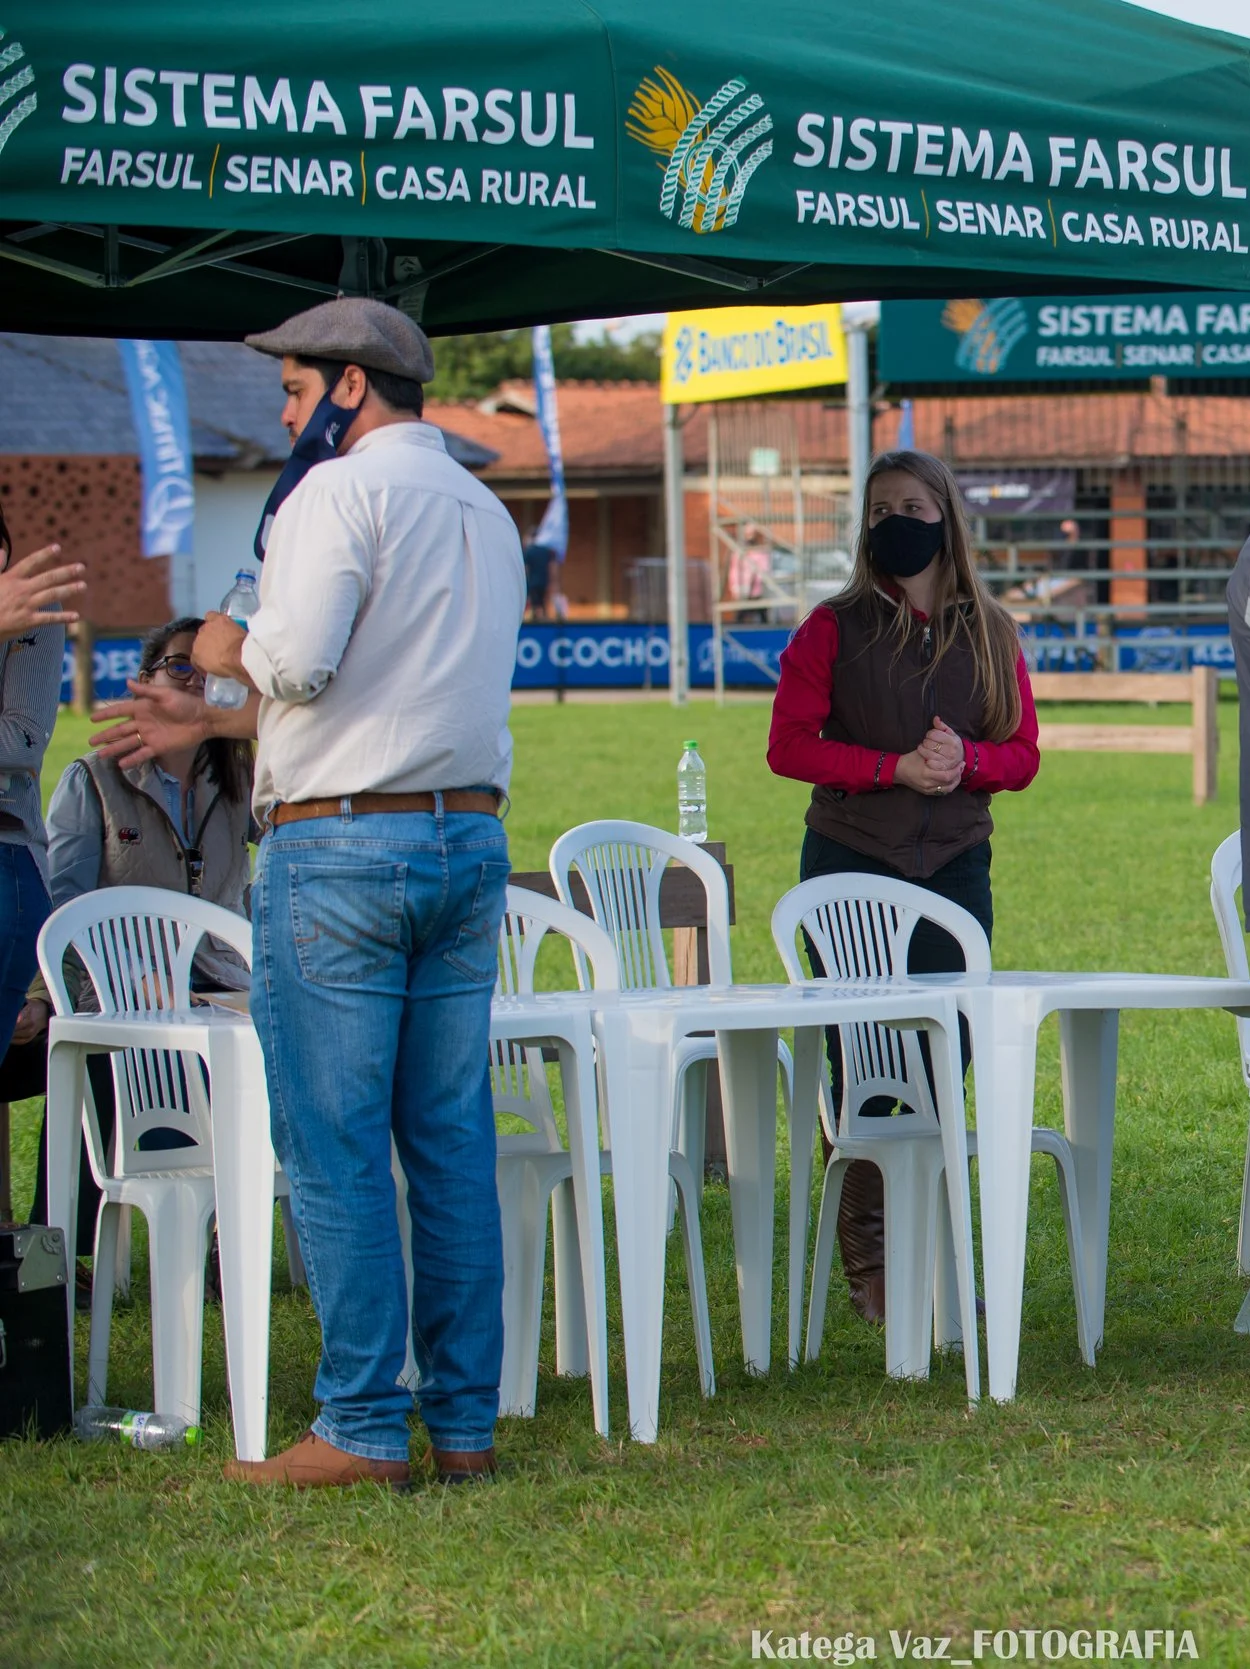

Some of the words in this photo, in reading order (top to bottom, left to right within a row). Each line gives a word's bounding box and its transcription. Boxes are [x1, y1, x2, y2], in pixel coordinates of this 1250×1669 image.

[61, 63, 347, 135] SISTEMA
[359, 85, 595, 149] FARSUL
[60, 147, 202, 190] FARSUL
[223, 154, 355, 197] SENAR
[375, 165, 471, 203] CASA
[480, 169, 597, 210] RURAL
[792, 112, 1034, 183] SISTEMA
[1048, 136, 1248, 199] FARSUL
[795, 189, 920, 230] FARSUL
[935, 199, 1047, 239] SENAR
[1061, 211, 1145, 246] CASA
[1150, 215, 1249, 254] RURAL
[1038, 305, 1189, 336] SISTEMA
[1036, 345, 1115, 367] FARSUL
[1122, 344, 1195, 366] SENAR
[548, 636, 671, 668] COCHO
